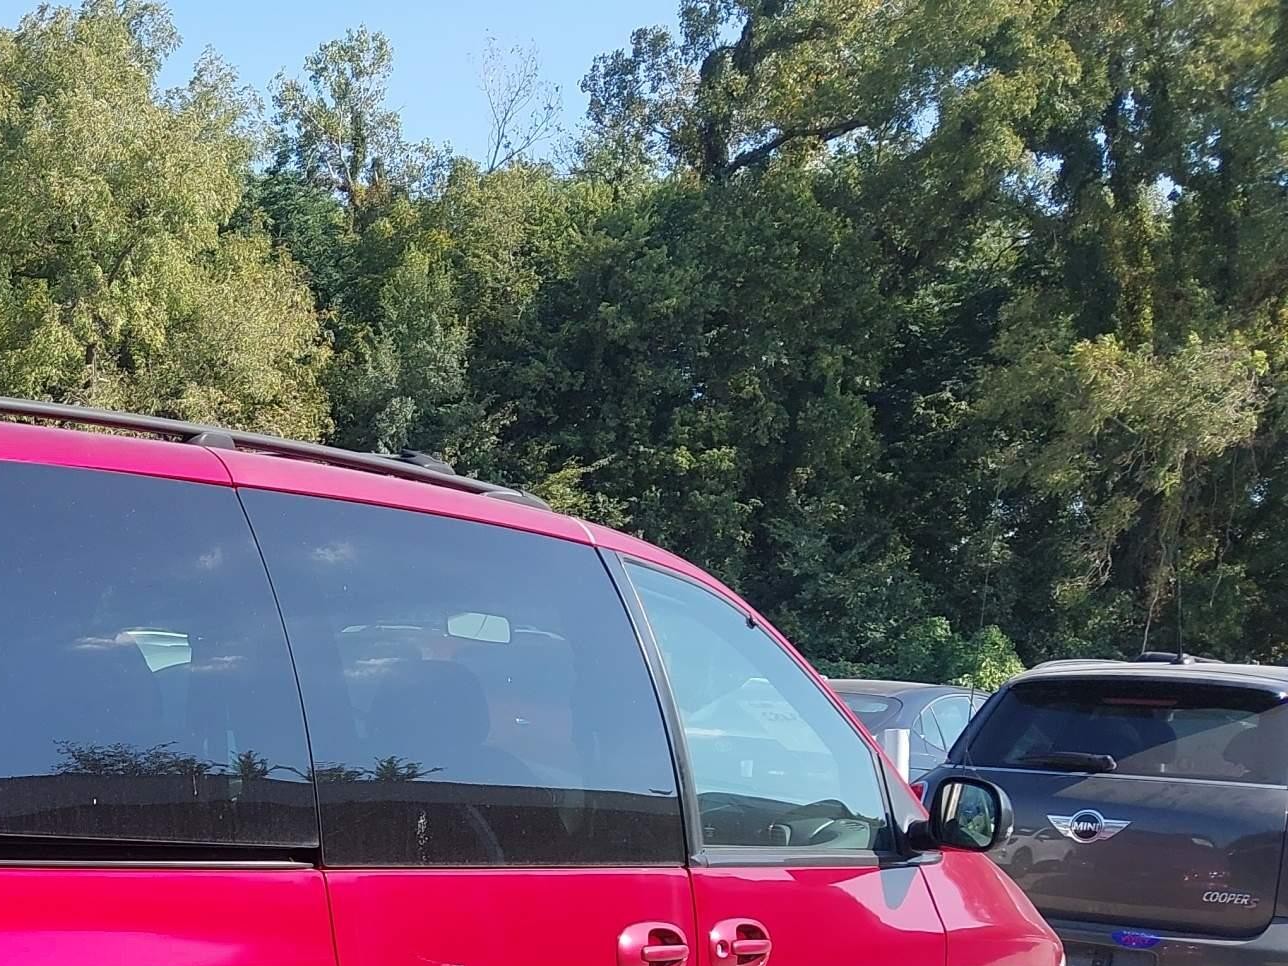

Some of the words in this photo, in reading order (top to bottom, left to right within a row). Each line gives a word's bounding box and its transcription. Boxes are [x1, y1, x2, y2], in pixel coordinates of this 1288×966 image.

[1072, 821, 1100, 832] MINI
[1202, 891, 1251, 905] COOPER
[1243, 897, 1261, 909] S
